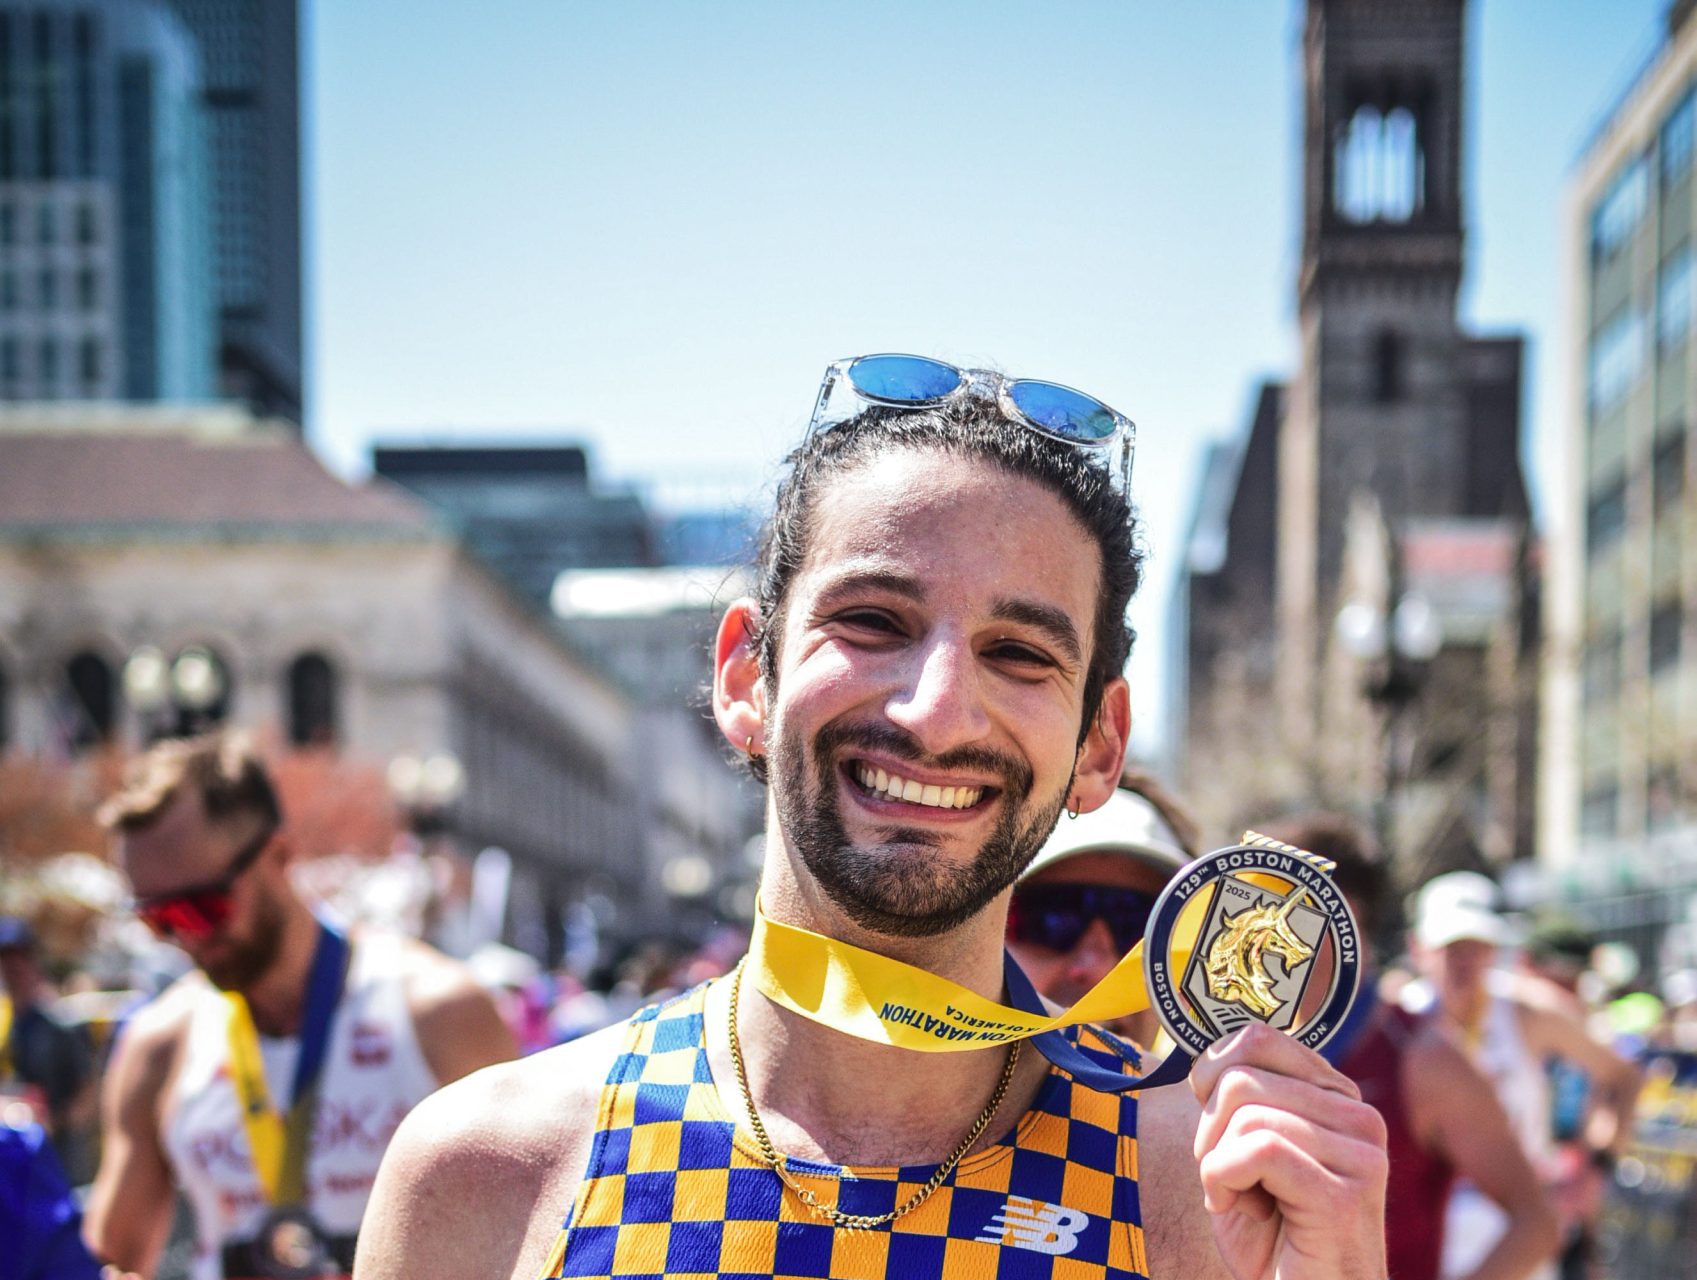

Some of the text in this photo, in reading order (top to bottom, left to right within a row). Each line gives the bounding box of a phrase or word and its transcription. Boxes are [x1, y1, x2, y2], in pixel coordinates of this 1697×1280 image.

[1215, 852, 1293, 872] BOSTON
[1297, 866, 1355, 963] MARATHON
[1225, 884, 1251, 900] 2025
[879, 1002, 977, 1041] MARATHON
[945, 1005, 1006, 1029] AMERICA
[1153, 962, 1179, 1021] BOSTON
[1176, 1022, 1206, 1050] ATHL
